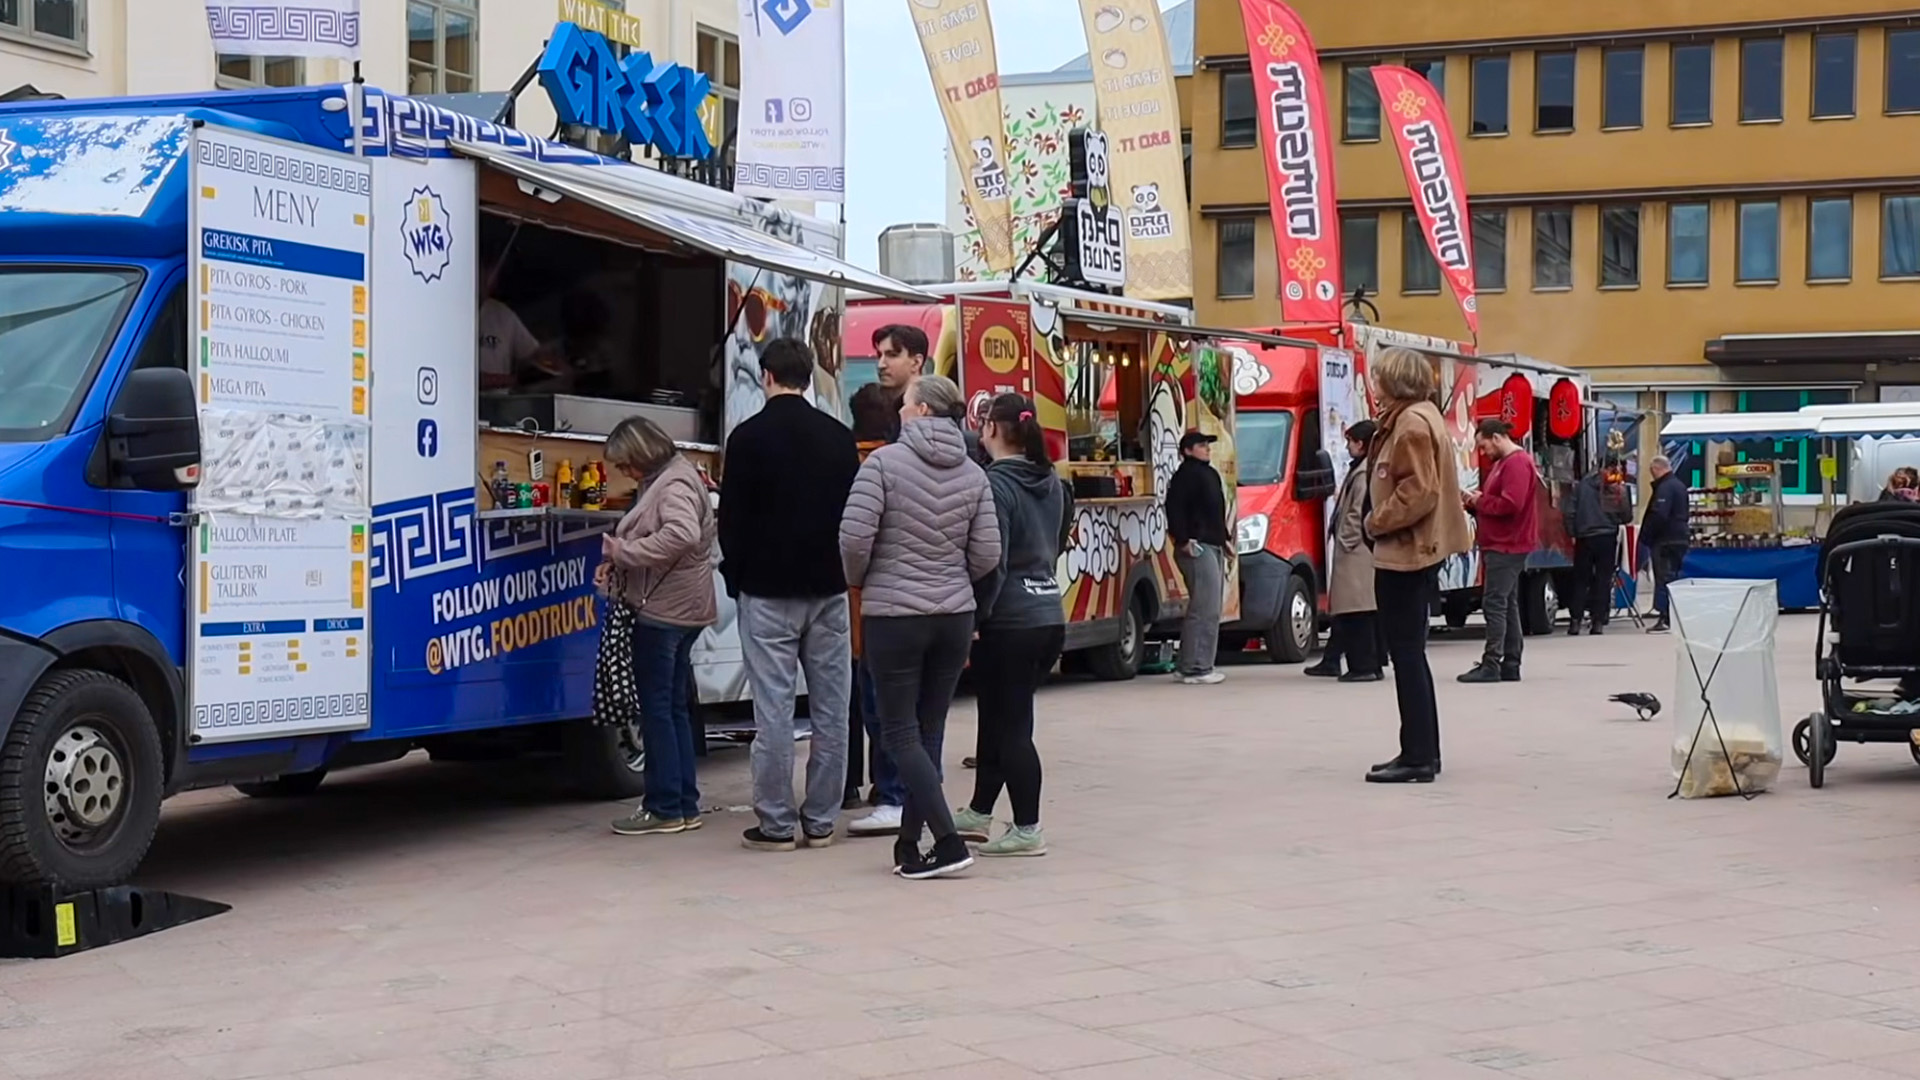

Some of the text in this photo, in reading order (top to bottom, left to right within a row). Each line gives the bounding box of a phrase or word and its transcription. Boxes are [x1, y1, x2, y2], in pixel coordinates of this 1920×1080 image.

[563, 0, 639, 44] WHAT THE
[538, 20, 715, 160] GREEK
[252, 185, 320, 228] MENY
[409, 223, 445, 259] WTG
[1080, 209, 1121, 249] BAO
[203, 231, 274, 257] GREKISK PITA
[1083, 244, 1122, 273] BUNS
[210, 267, 232, 285] PITA
[234, 274, 271, 292] GYROS
[280, 277, 308, 296] PORK
[210, 303, 232, 321] PITA
[234, 309, 271, 326] GYROS
[280, 312, 325, 332] CHICKEN
[210, 340, 290, 364] PITA HALLOUMI
[984, 336, 1016, 360] MENU
[210, 377, 267, 397] MEGA PITA
[209, 525, 298, 543] HALLOUMI PLATE
[210, 564, 268, 581] GLUTENFRI
[217, 582, 258, 599] TALLRIK
[432, 555, 587, 625] FOLLOW OUR STORY
[243, 621, 267, 634] EXTRA
[425, 593, 597, 676] @WTG.FOODTRUCK
